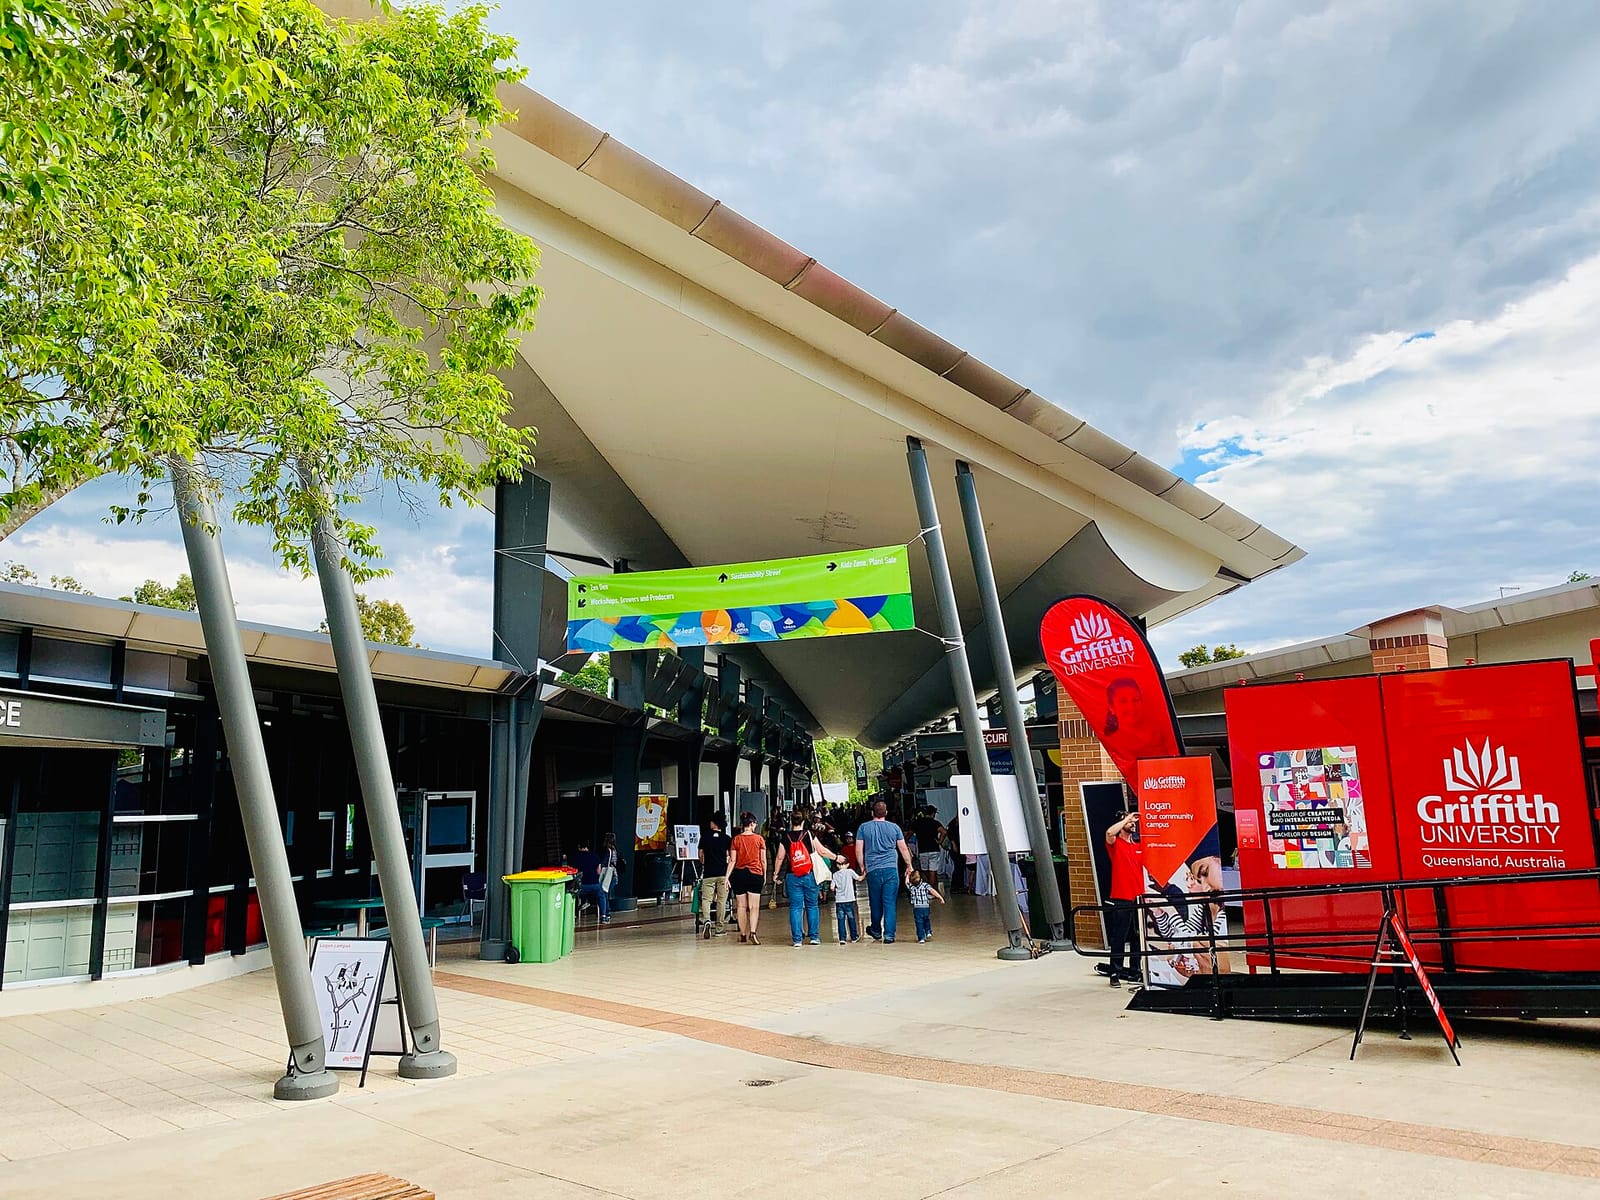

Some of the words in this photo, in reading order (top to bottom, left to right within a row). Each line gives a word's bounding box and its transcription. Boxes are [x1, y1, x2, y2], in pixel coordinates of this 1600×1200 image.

[1059, 636, 1134, 665] Griffith
[1063, 651, 1135, 676] UNIVERSITY
[1158, 775, 1186, 785] Griffith
[1144, 800, 1172, 812] Logan
[1416, 793, 1560, 824] Griffith
[1145, 812, 1158, 820] Our
[1158, 812, 1194, 821] community
[1146, 821, 1170, 829] campus
[1420, 825, 1560, 844] UNIVERSITY
[1422, 854, 1502, 869] Queensland,
[1504, 855, 1566, 869] Australia
